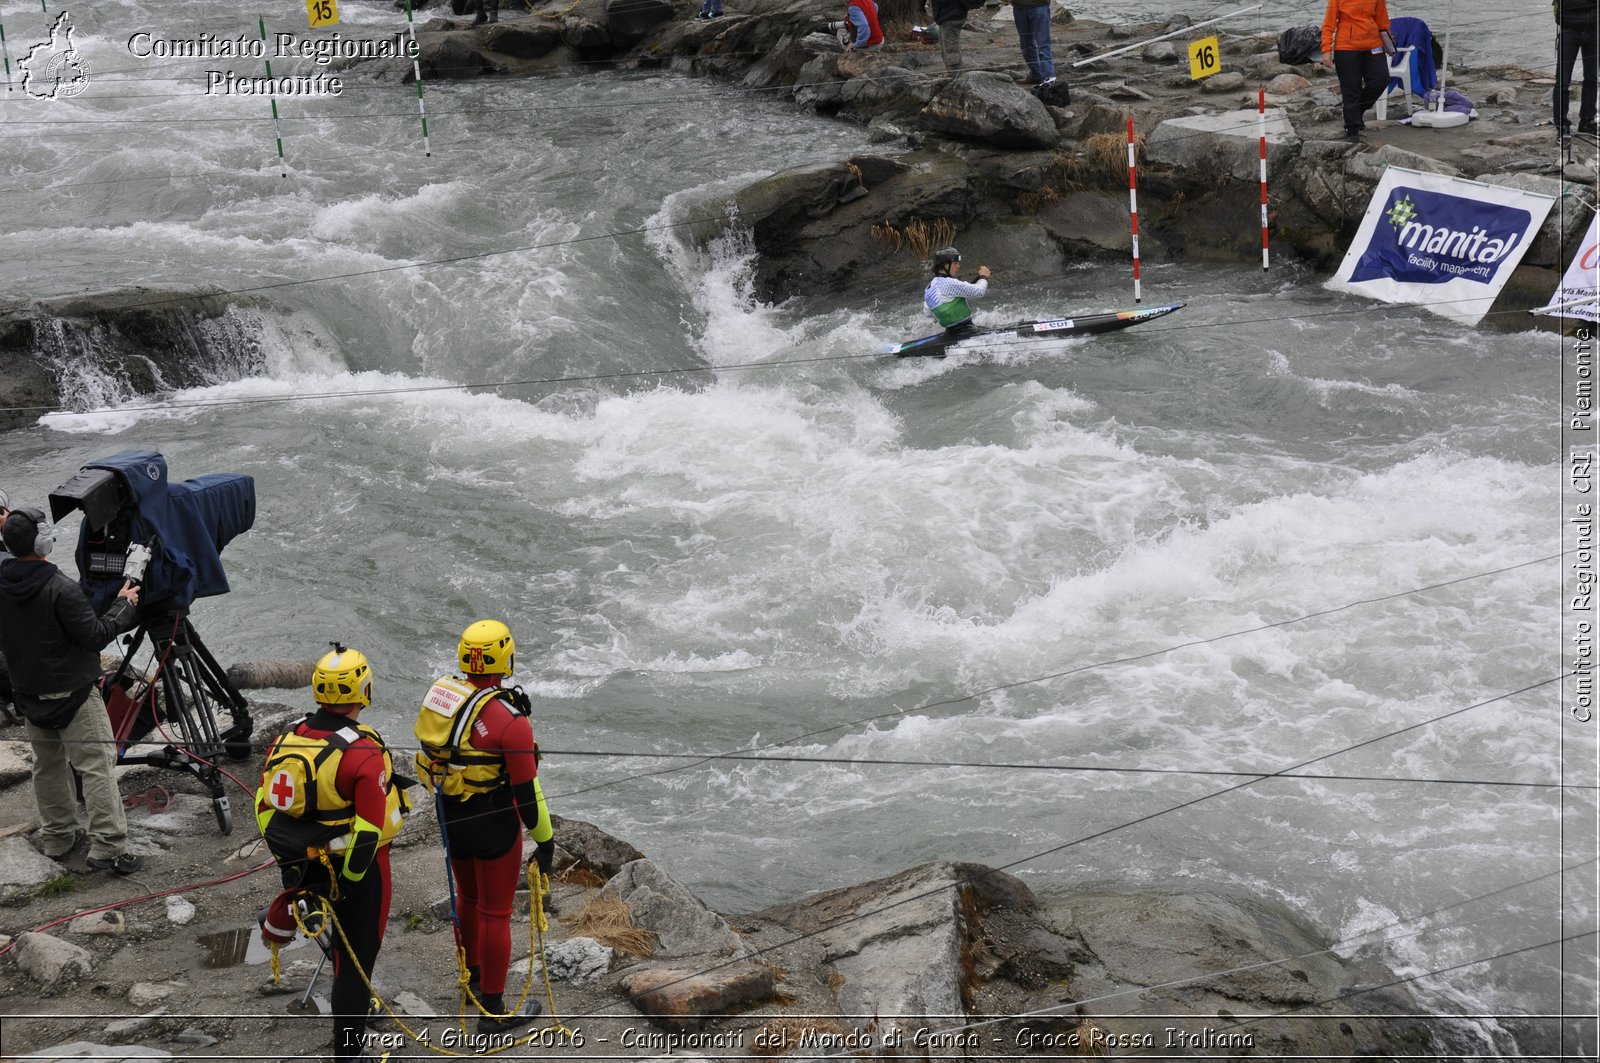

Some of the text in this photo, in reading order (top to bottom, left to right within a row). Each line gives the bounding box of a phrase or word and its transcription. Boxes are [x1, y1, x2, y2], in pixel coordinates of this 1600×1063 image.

[313, 1, 332, 20] 15
[1196, 46, 1214, 70] 16
[1398, 221, 1518, 263] manital
[1408, 253, 1438, 271] facility
[470, 647, 483, 661] GR
